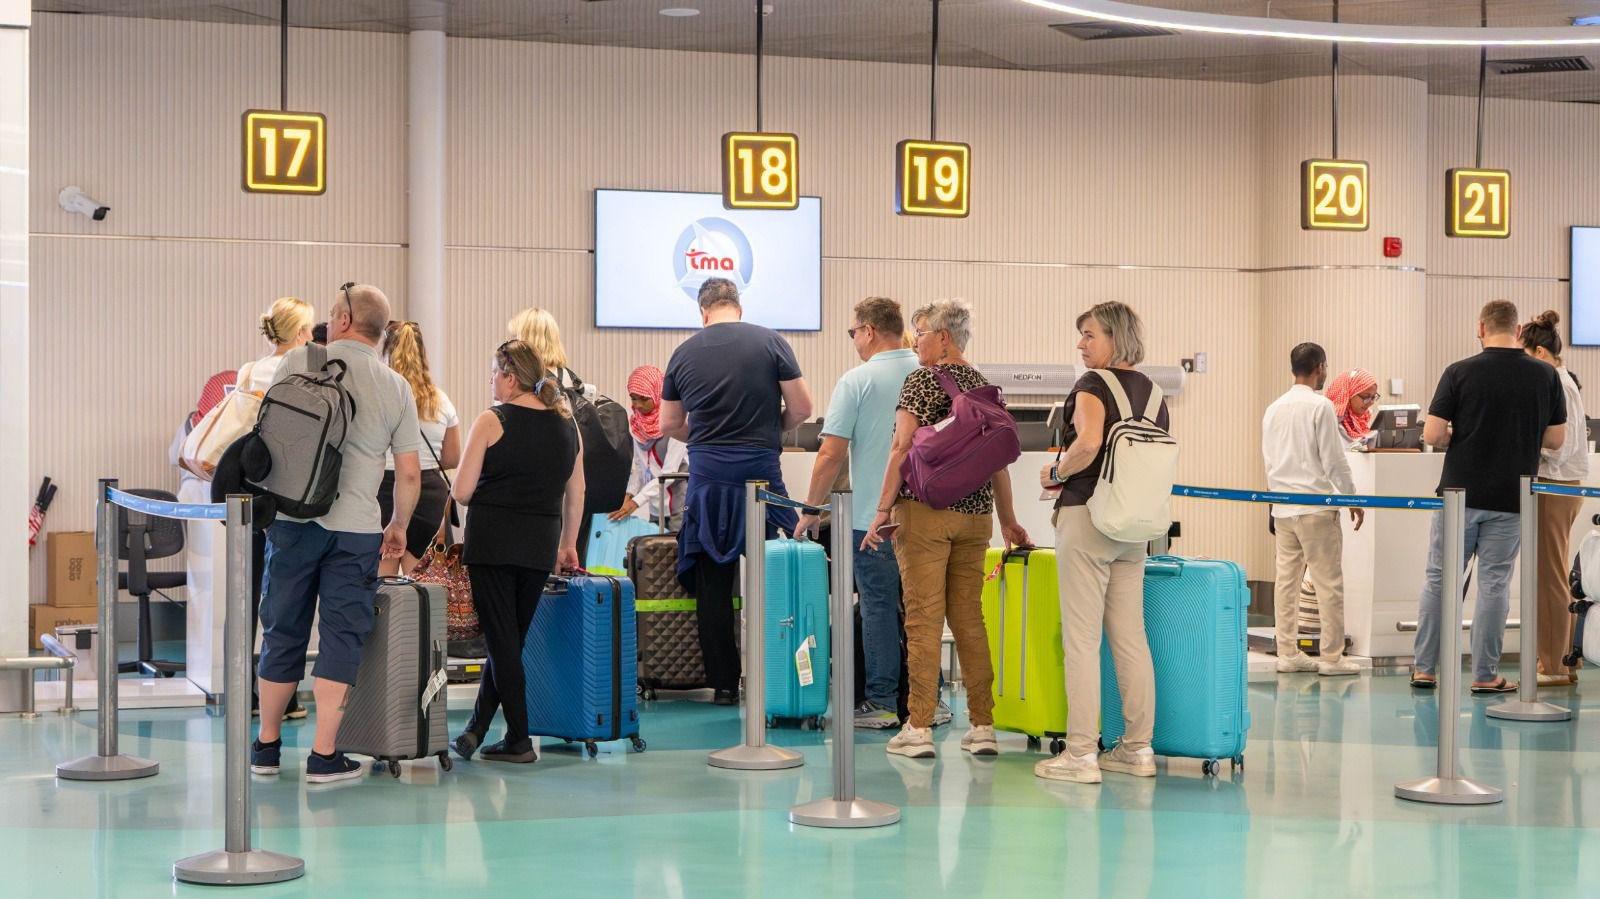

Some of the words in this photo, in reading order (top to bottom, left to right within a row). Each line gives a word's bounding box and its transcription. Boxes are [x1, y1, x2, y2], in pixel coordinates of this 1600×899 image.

[259, 127, 312, 178] 17
[738, 147, 789, 196] 18
[913, 155, 960, 203] 19
[1315, 173, 1363, 217] 20
[1463, 182, 1501, 225] 21
[685, 248, 734, 271] tma
[1013, 373, 1042, 381] NEDFON
